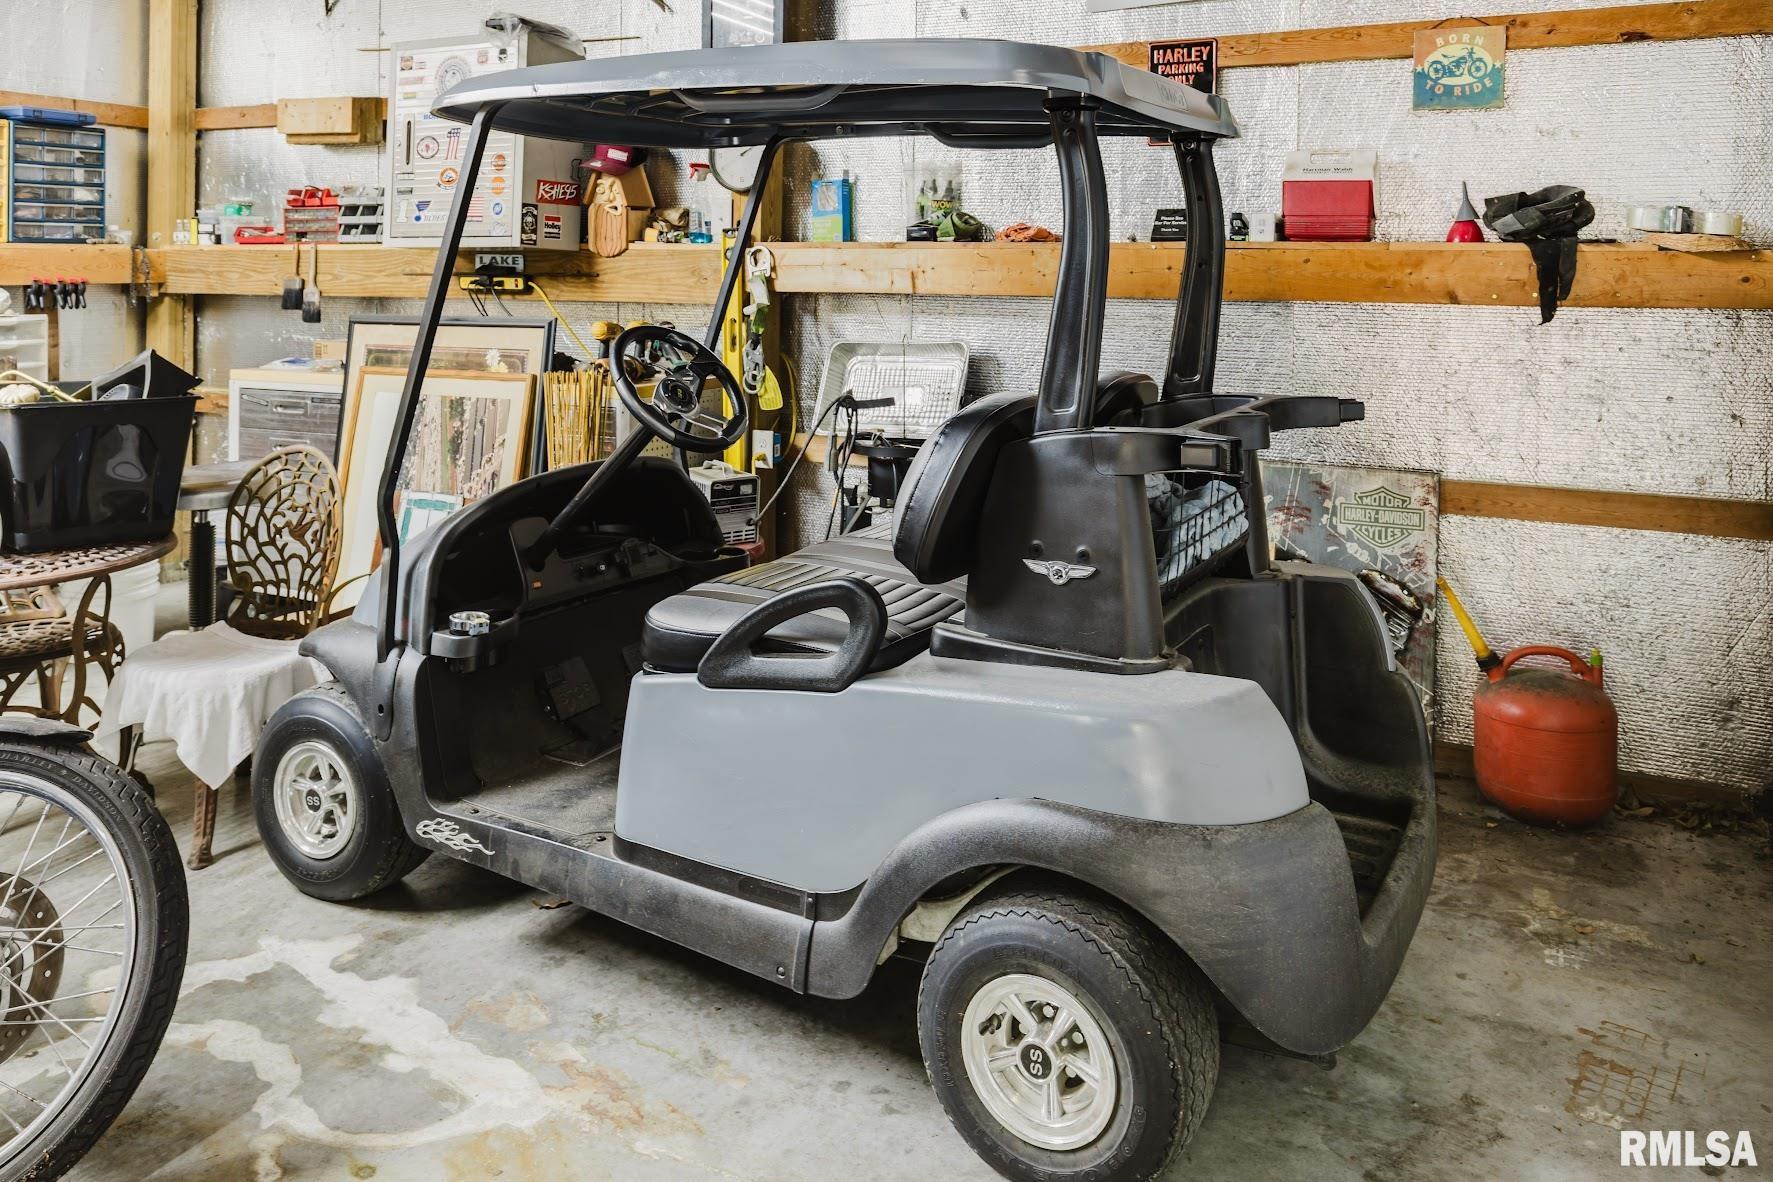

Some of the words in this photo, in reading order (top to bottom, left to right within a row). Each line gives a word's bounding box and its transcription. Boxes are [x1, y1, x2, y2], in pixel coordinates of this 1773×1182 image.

[1435, 33, 1484, 47] BORN
[1153, 46, 1211, 64] HARLEY
[1158, 62, 1205, 75] PARKING
[1425, 80, 1444, 94] TO
[1453, 77, 1493, 96] RIDE
[538, 182, 579, 201] KSHE95
[931, 200, 954, 209] WOW
[544, 222, 561, 232] Holley
[480, 256, 520, 266] LAKE
[1362, 493, 1403, 508] MOTOR
[1345, 507, 1420, 527] HARLEY-DAVIDSON
[1361, 525, 1402, 544] CYCLES
[71, 776, 124, 822] DAVIDSON
[306, 796, 320, 806] SS
[1029, 1049, 1043, 1076] SS
